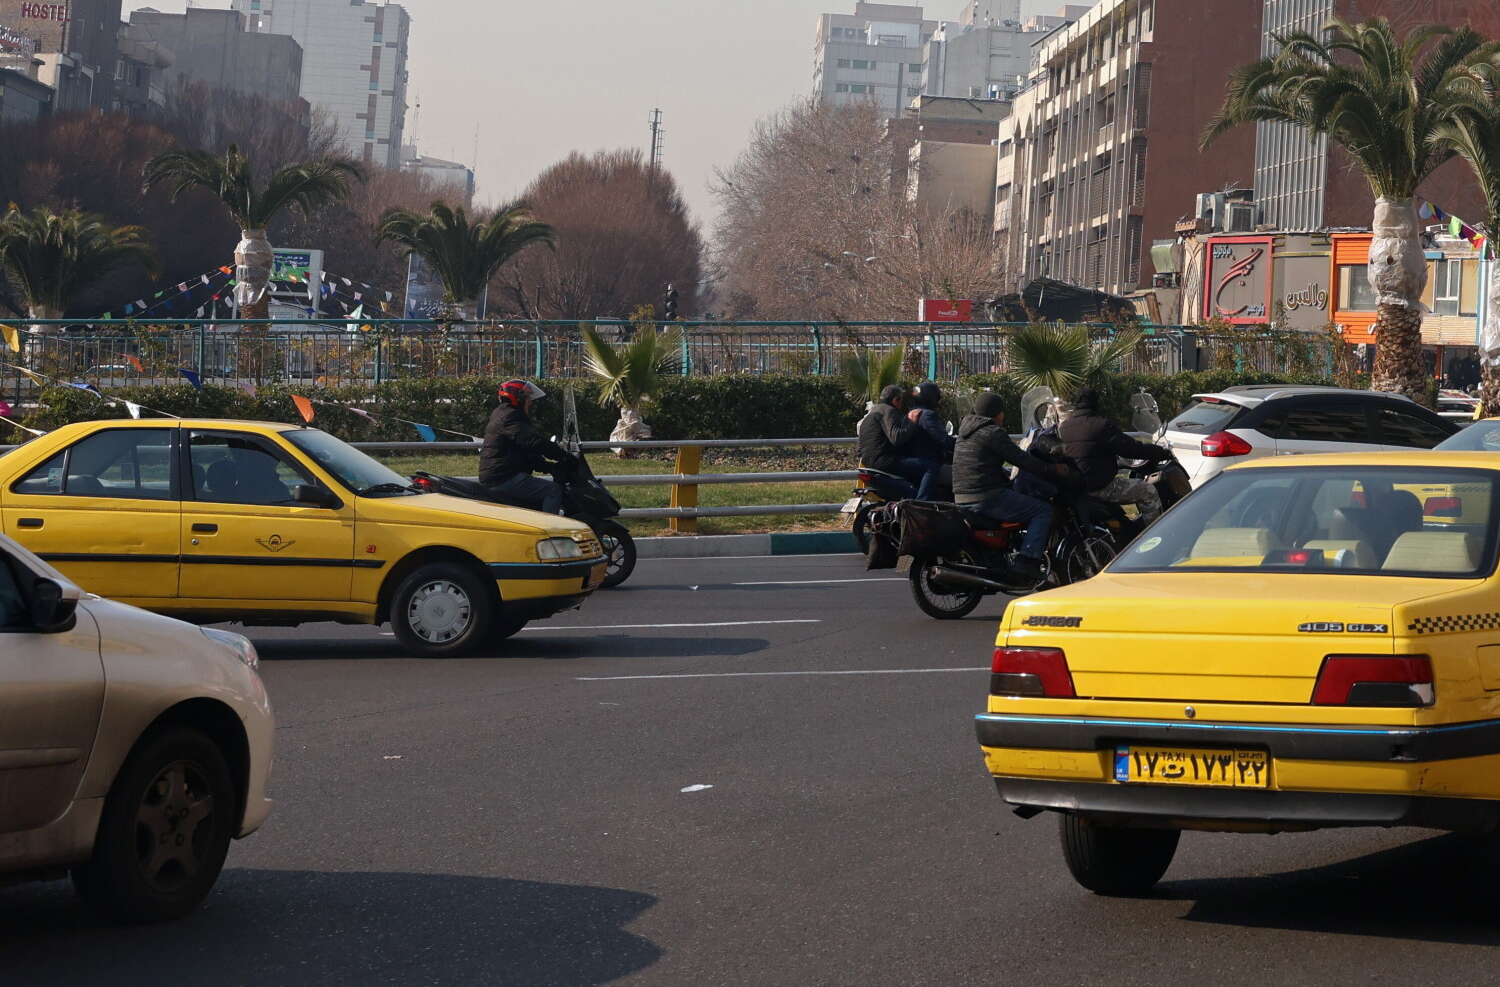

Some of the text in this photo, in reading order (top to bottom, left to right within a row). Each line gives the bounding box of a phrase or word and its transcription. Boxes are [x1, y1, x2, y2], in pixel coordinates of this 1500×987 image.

[22, 2, 71, 22] HOSTEL
[1286, 283, 1328, 310] والس
[1298, 622, 1386, 633] 405 GLX
[1161, 751, 1186, 762] TAXI
[1133, 750, 1159, 778] ۱۷
[1189, 753, 1232, 782] ۱۷۳
[1236, 760, 1265, 784] ۲۲
